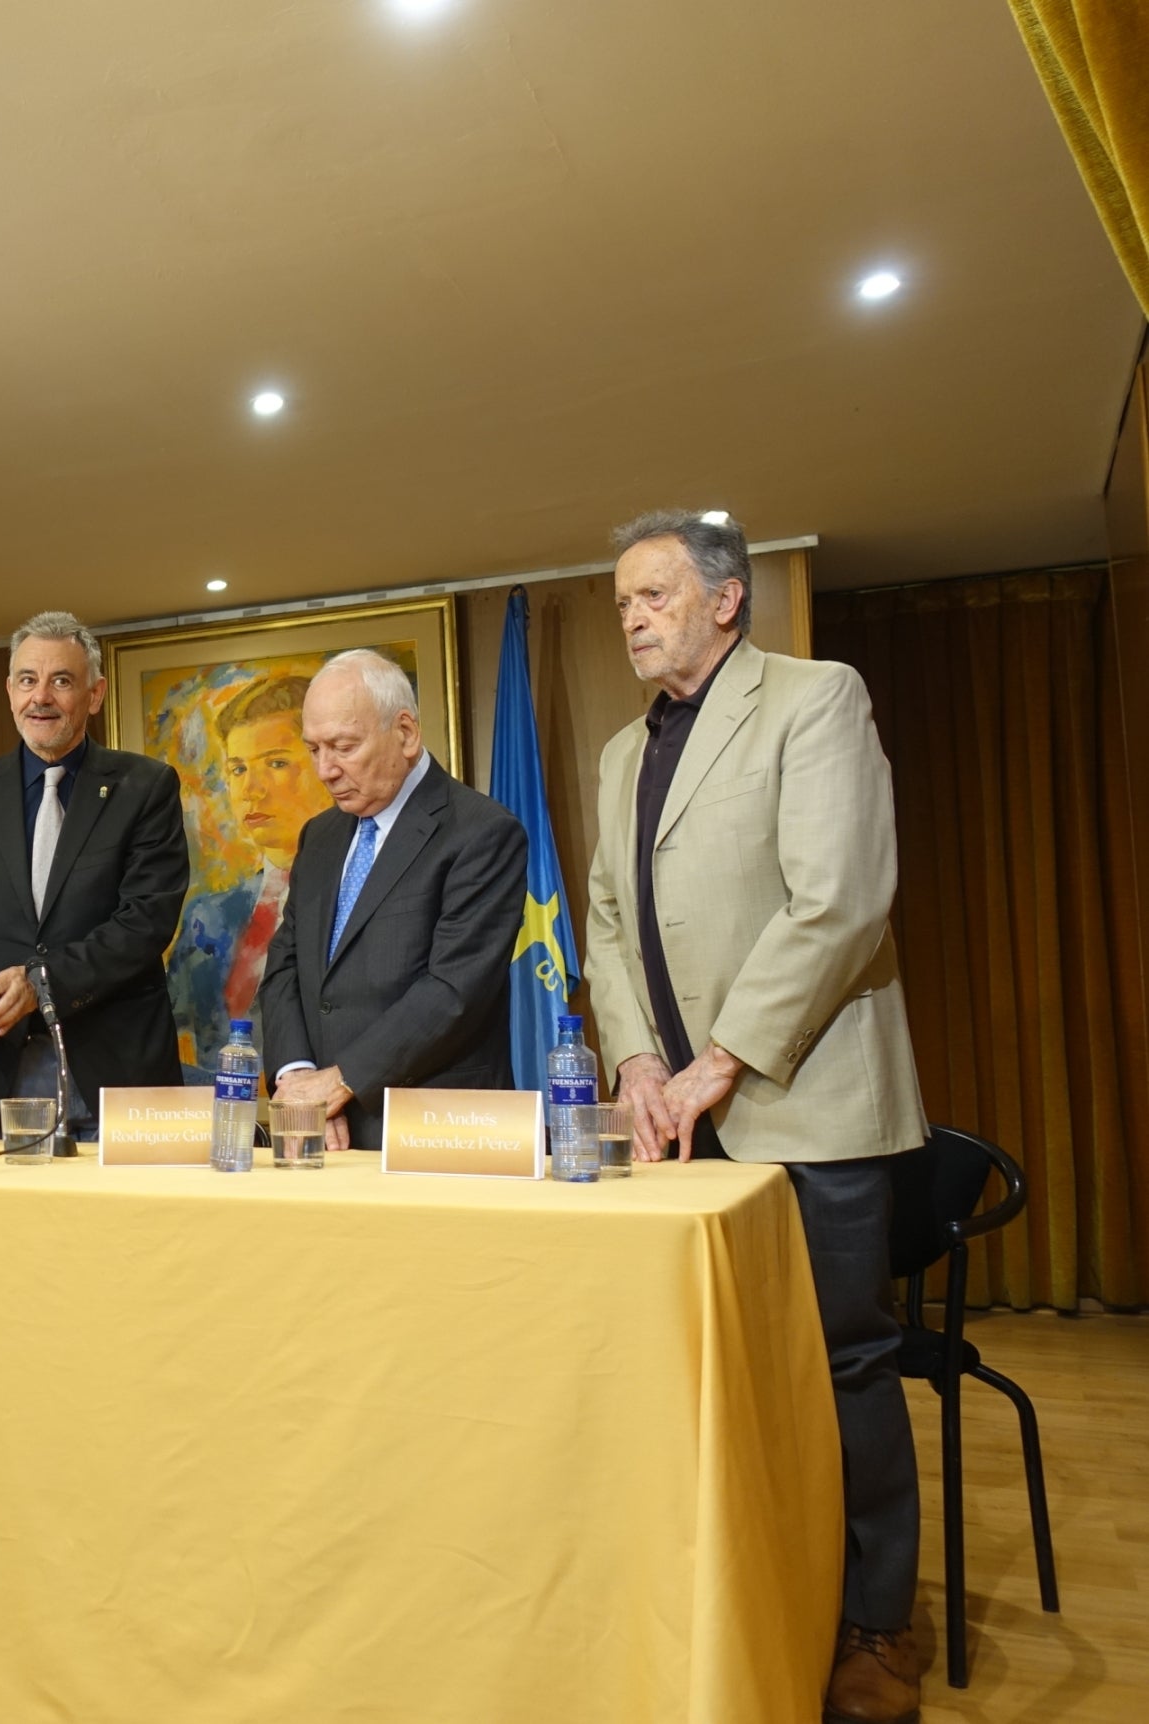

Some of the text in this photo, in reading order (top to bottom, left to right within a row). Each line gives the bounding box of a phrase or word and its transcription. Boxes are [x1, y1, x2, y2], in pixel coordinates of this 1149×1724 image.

[128, 1107, 212, 1121] D. Francisco
[423, 1111, 498, 1127] D. Andrés
[478, 1134, 522, 1151] Pérez
